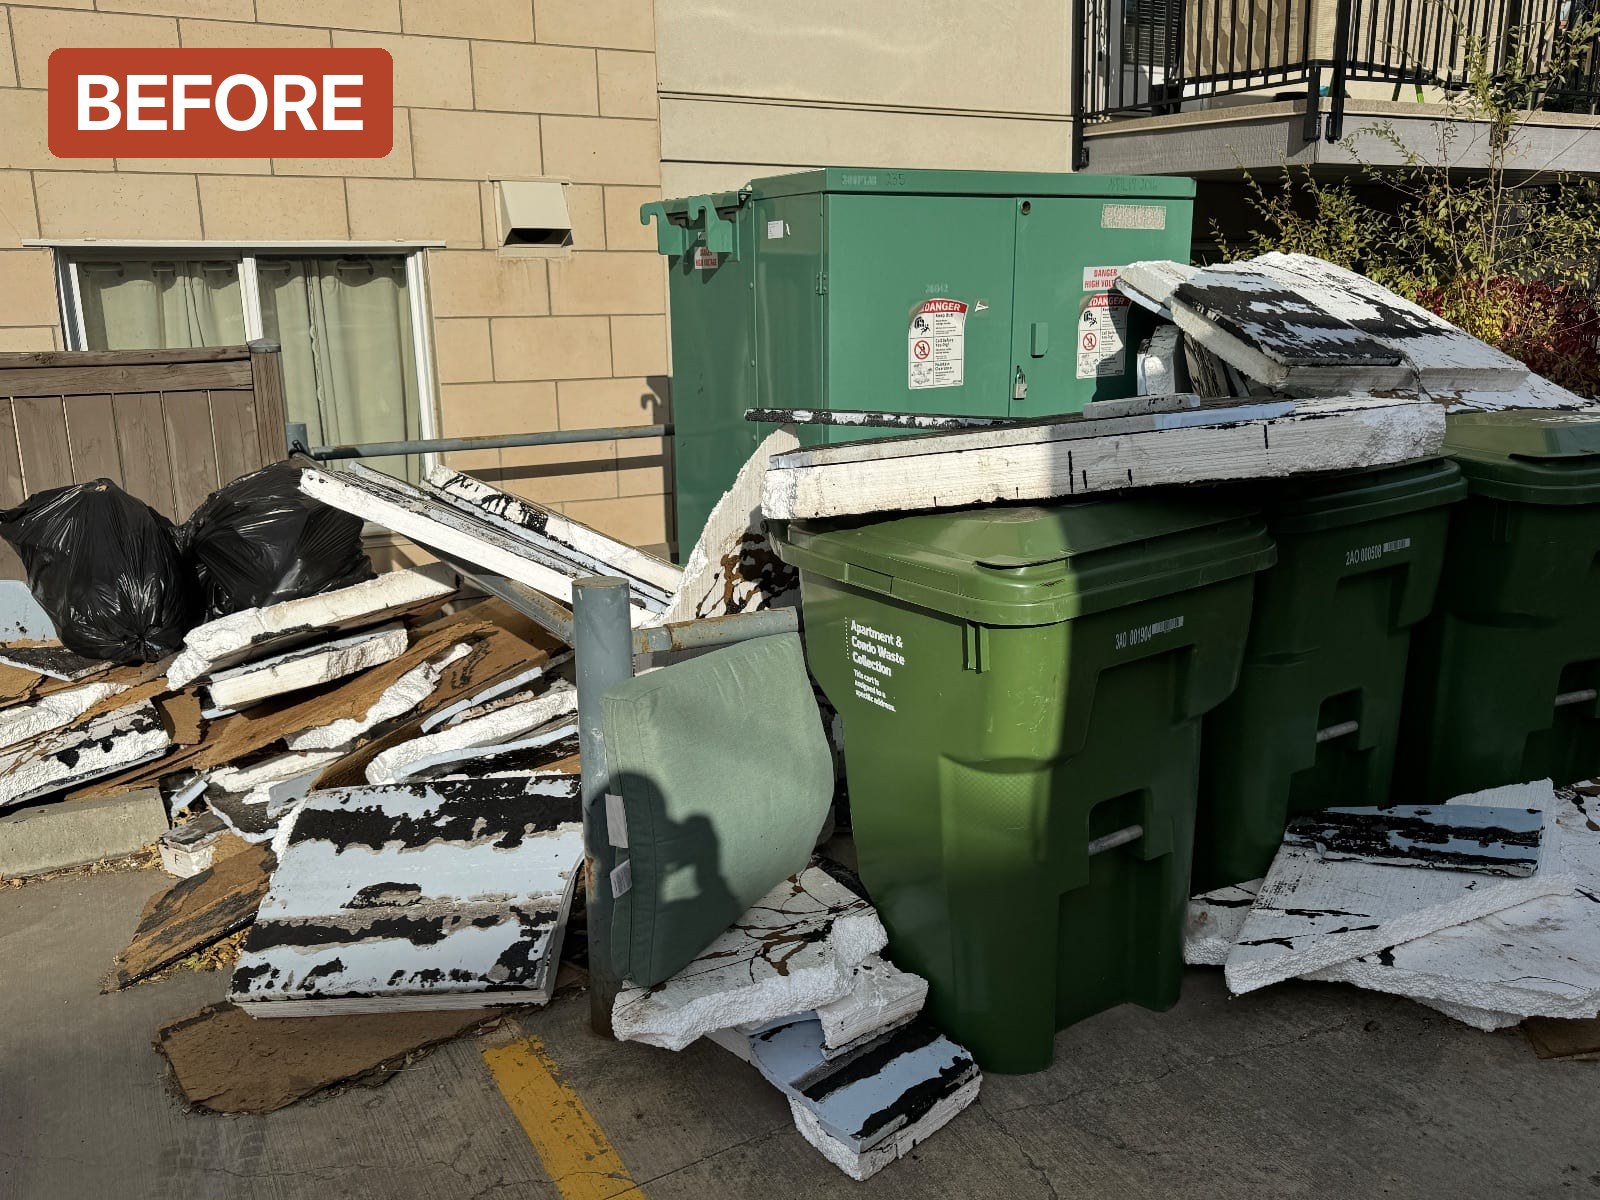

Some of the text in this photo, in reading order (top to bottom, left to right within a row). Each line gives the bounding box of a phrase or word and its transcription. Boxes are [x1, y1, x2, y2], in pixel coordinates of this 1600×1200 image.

[1093, 268, 1117, 277] DANGER
[1084, 279, 1115, 288] HIGH VOLT
[1092, 297, 1124, 306] DANGER
[924, 302, 960, 312] DANGER
[851, 620, 903, 648] Apartment &
[852, 635, 905, 665] Condo Waste
[853, 651, 892, 677] Collection
